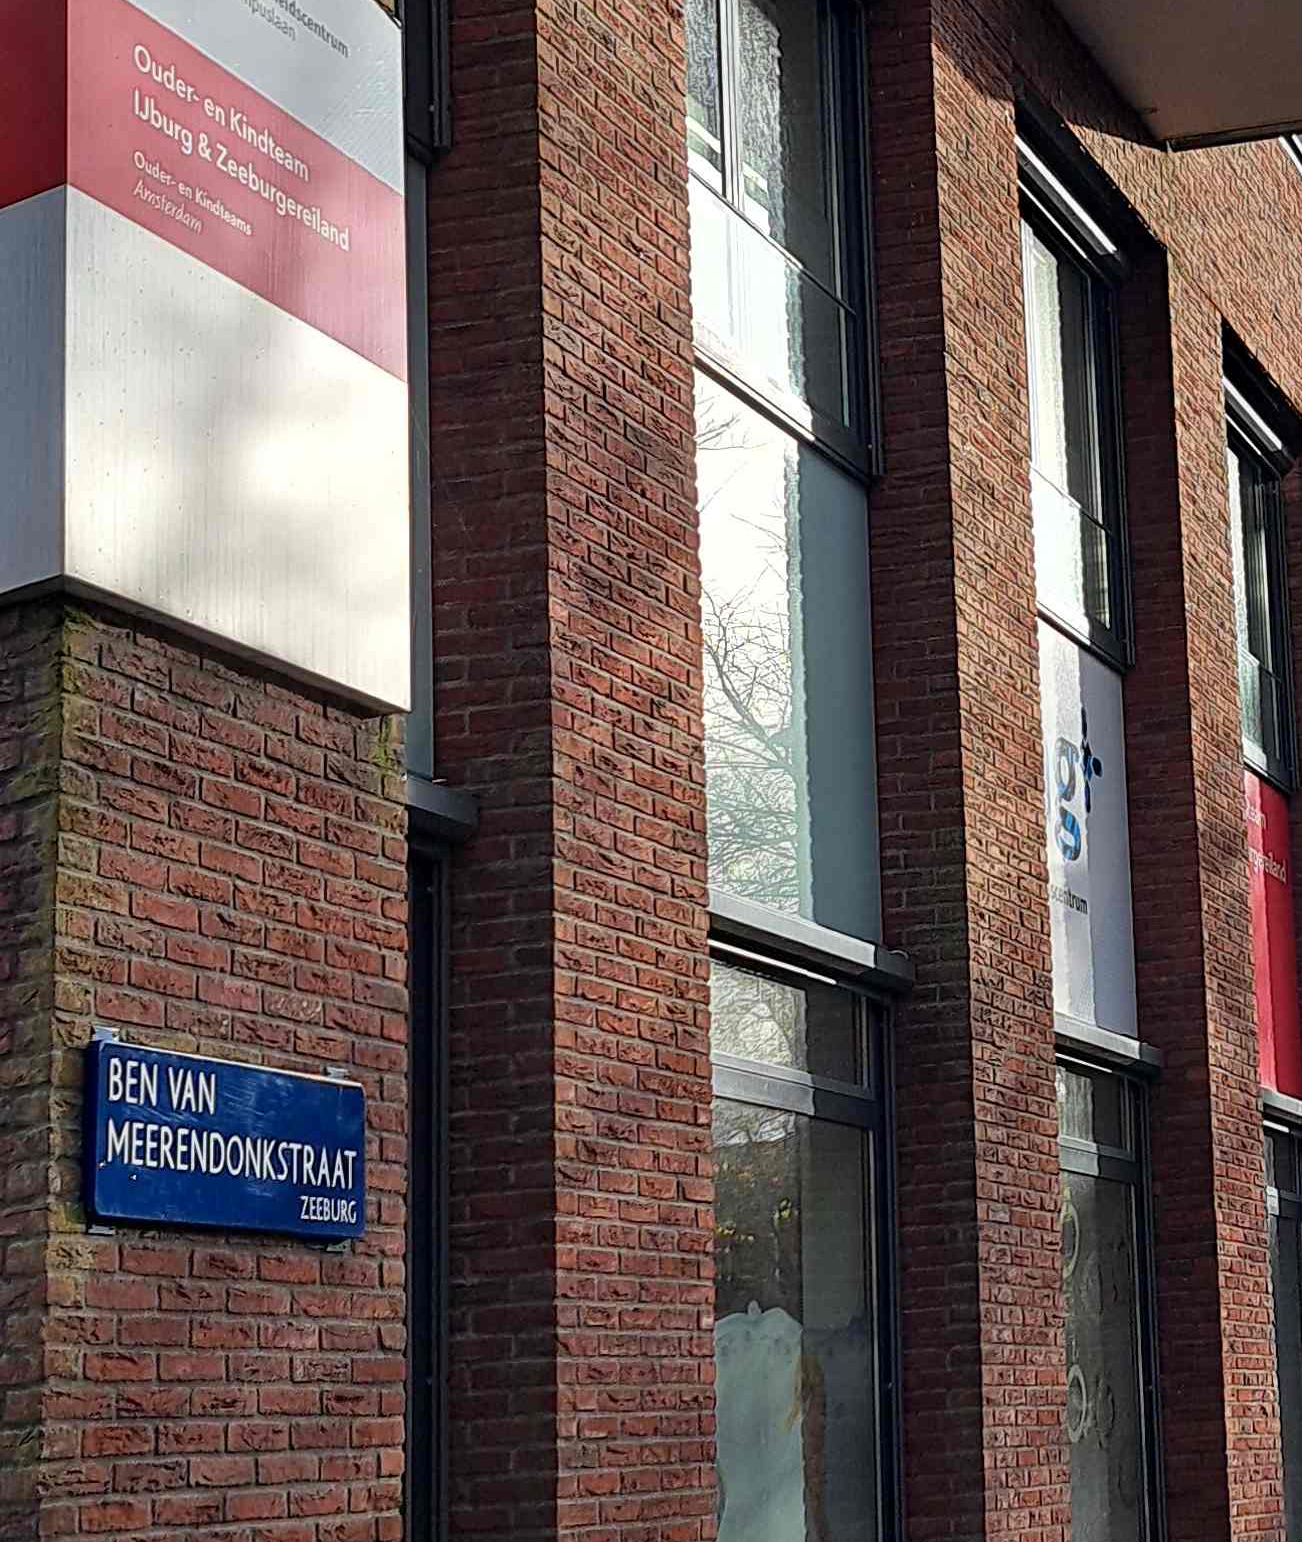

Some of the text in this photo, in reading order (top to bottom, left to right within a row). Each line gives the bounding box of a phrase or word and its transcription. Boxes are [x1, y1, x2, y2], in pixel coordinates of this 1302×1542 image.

[134, 45, 309, 182] Ouder- en Kindteam
[134, 88, 350, 251] IJburg & Zeeburgereiland
[134, 151, 252, 236] Ouder- en Kindteams
[133, 179, 203, 234] Amsterdam
[108, 1057, 216, 1115] BEN VAN
[106, 1117, 357, 1190] MEERENDONKSTRAAT
[300, 1195, 357, 1224] ZEEBURG
